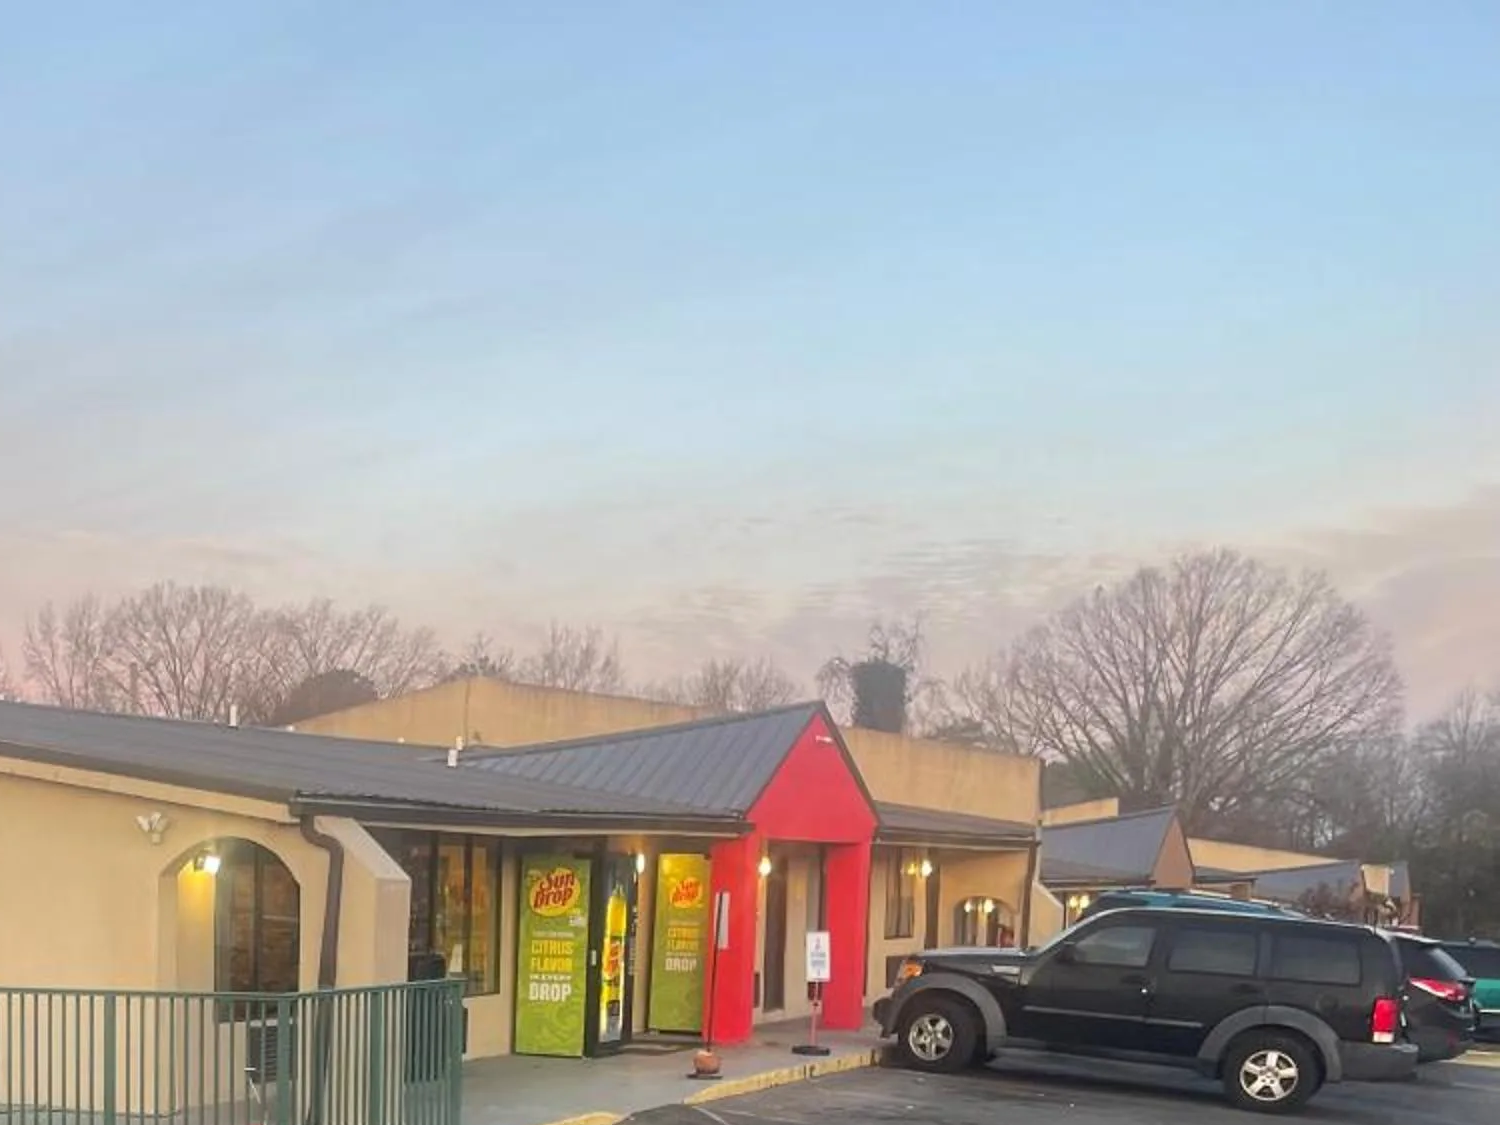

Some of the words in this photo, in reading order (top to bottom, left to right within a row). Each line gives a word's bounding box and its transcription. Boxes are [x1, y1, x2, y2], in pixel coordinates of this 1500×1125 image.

[540, 870, 575, 889] Sun
[533, 886, 574, 909] Drop
[531, 940, 574, 955] CITRUS
[530, 957, 573, 972] FLAVOR
[665, 957, 697, 972] DROP
[528, 982, 572, 1002] DROP
